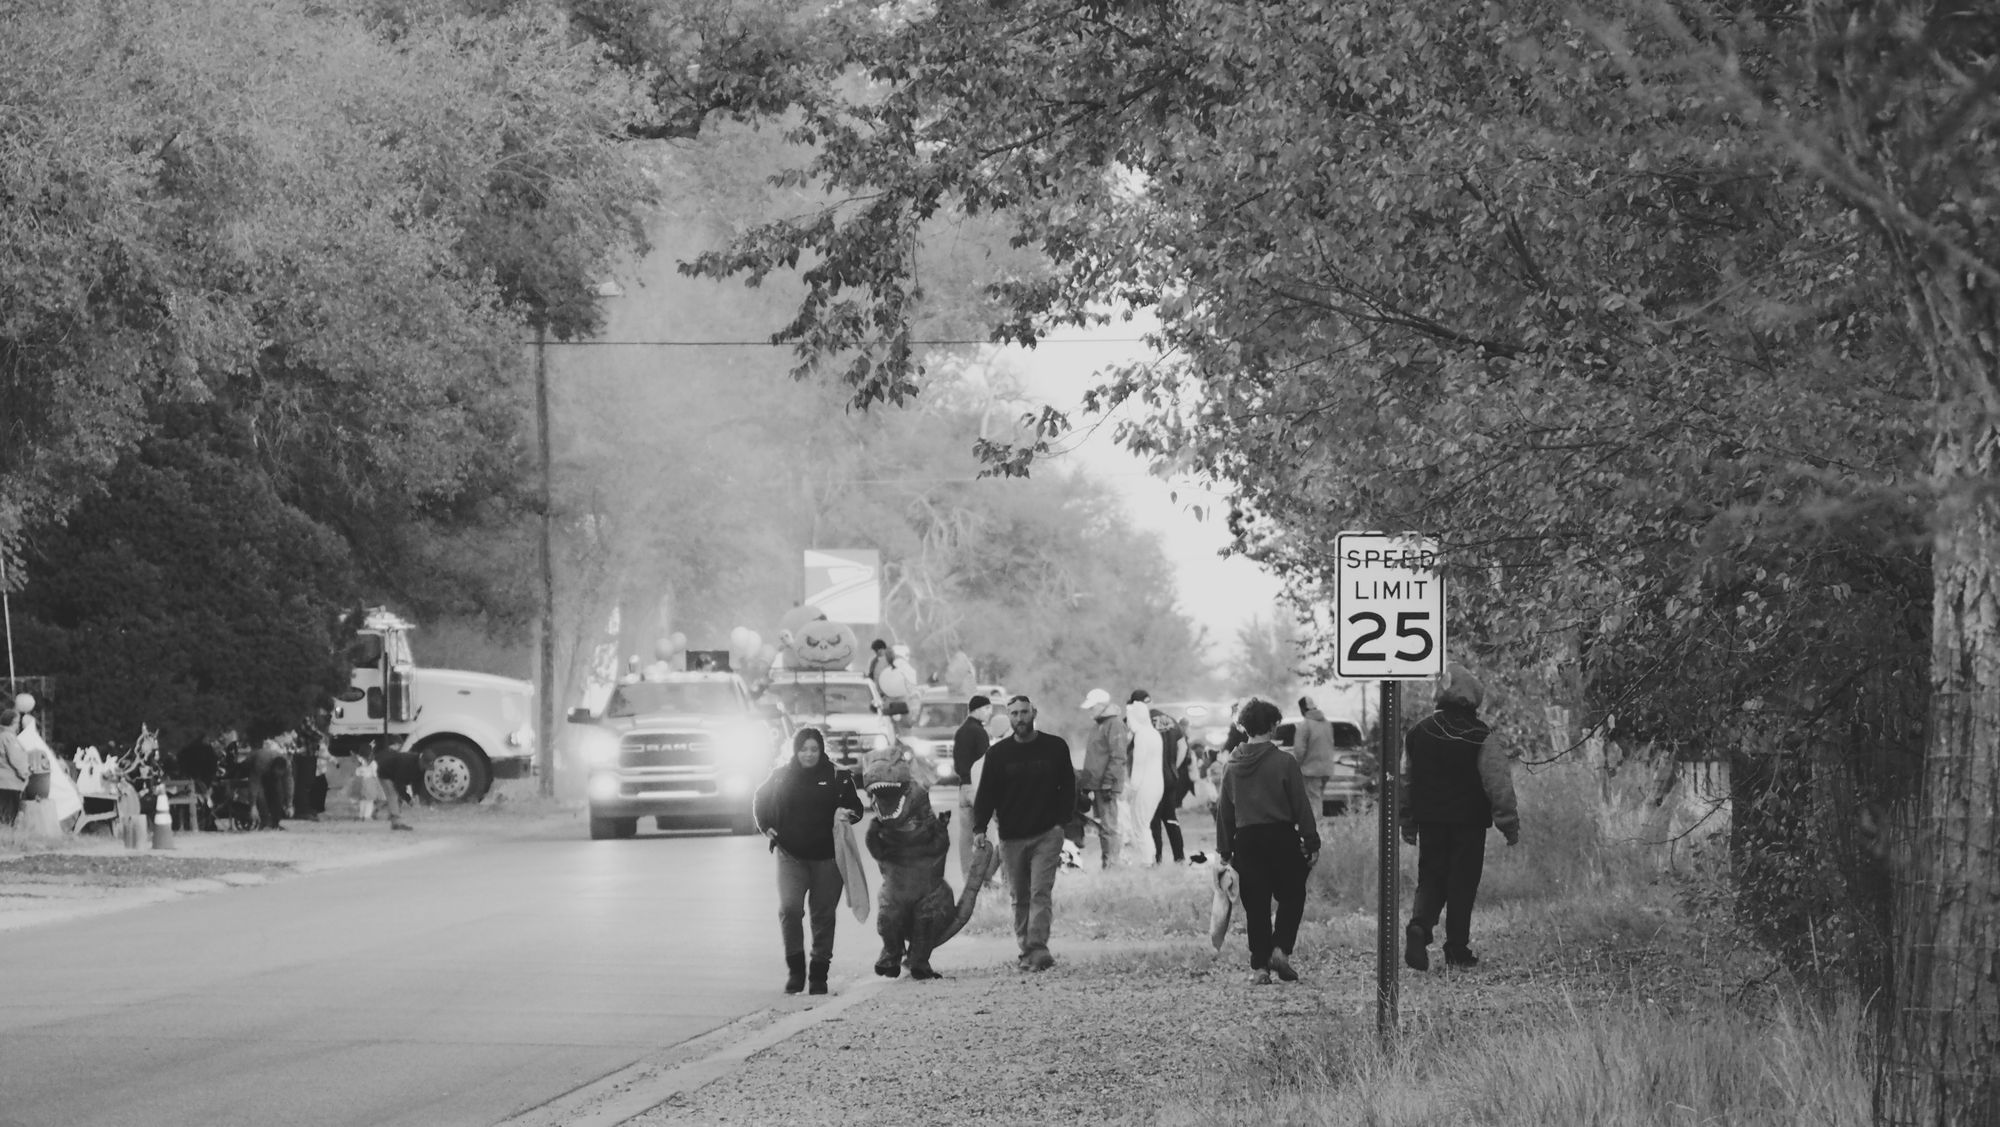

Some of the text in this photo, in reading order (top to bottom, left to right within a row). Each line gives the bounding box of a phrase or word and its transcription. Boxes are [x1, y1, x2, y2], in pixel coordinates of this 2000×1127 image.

[1347, 550, 1435, 568] SPEED
[1355, 581, 1428, 599] LIMIT
[1347, 611, 1433, 662] 25
[646, 743, 687, 752] RAM
